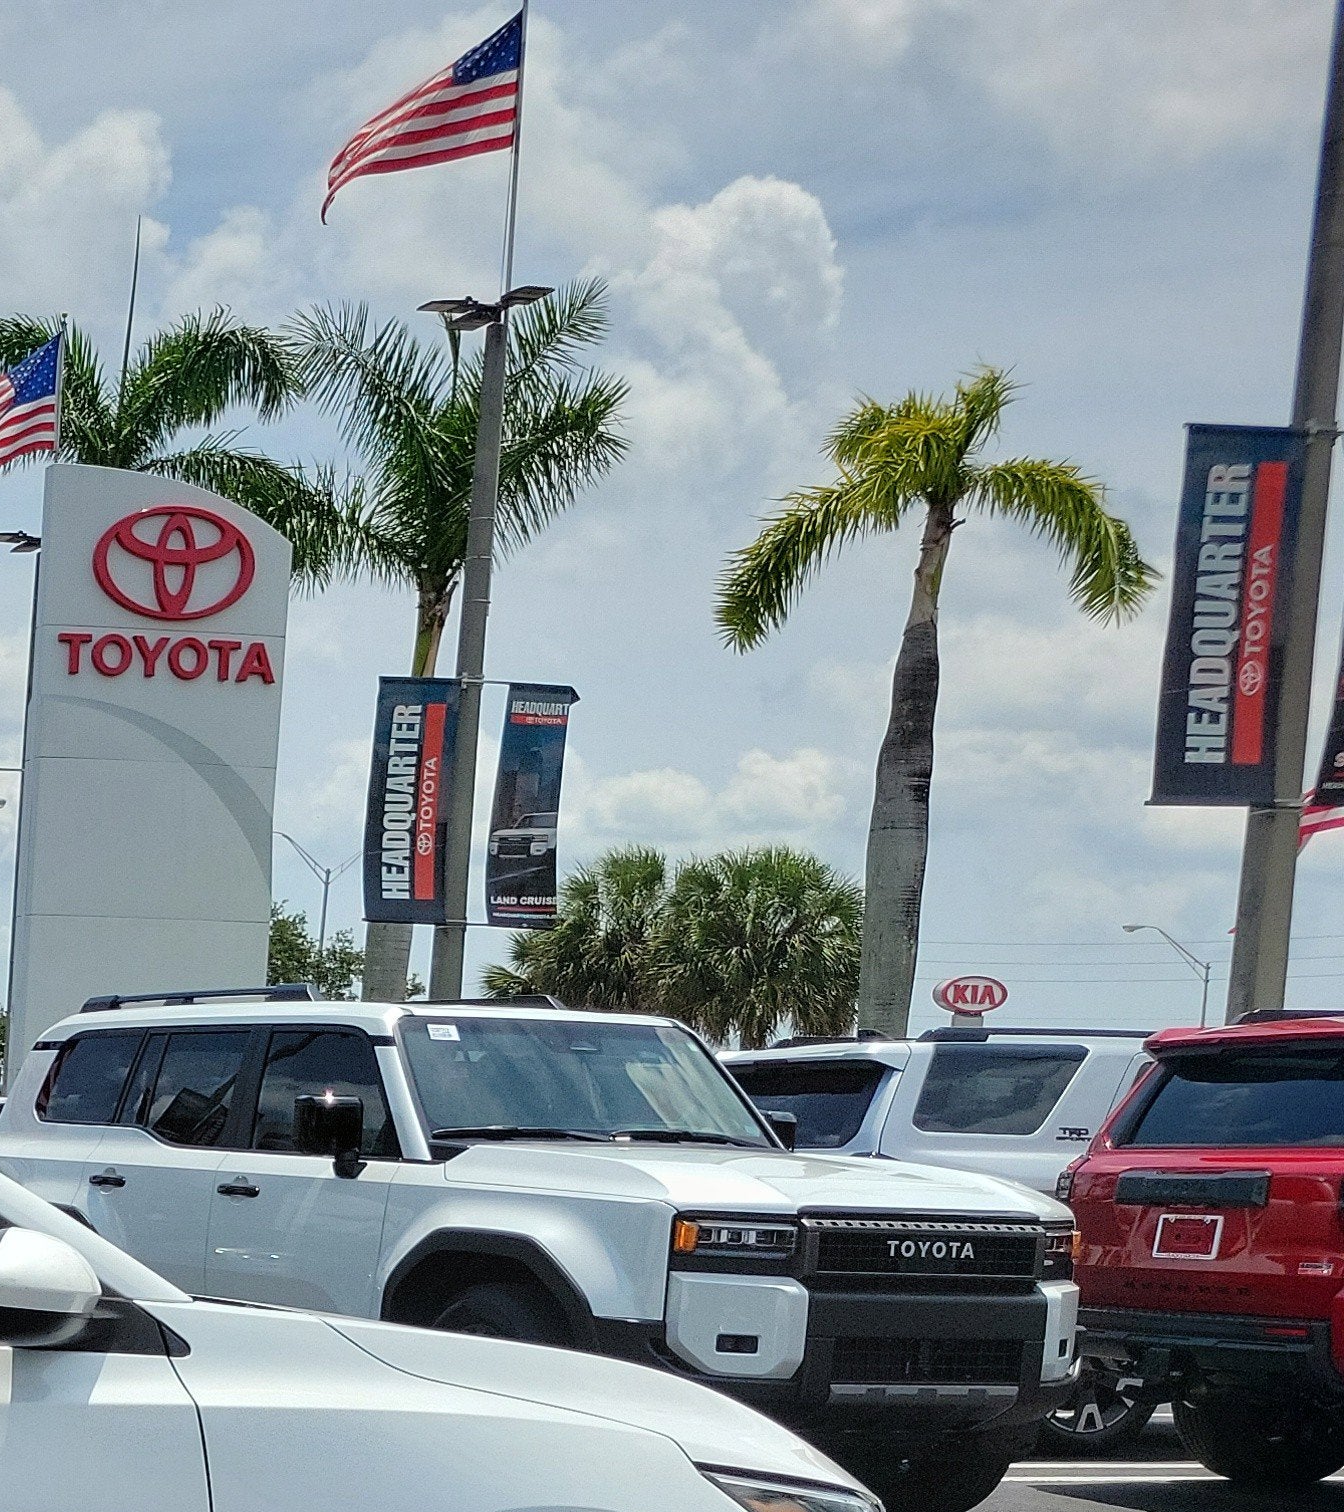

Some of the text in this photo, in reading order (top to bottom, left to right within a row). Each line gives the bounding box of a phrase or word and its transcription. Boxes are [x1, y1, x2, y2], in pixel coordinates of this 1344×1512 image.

[1184, 463, 1254, 764] HEADQUARTER
[1244, 544, 1275, 658] TOYOTA
[58, 632, 275, 685] TOYOTA
[511, 700, 570, 716] HEADQUART
[381, 704, 423, 900] HEADQUARTER
[419, 757, 437, 830] TOYOTA
[490, 896, 517, 905] LAND
[953, 985, 996, 1005] KIA
[887, 1240, 974, 1259] TOYOTA
